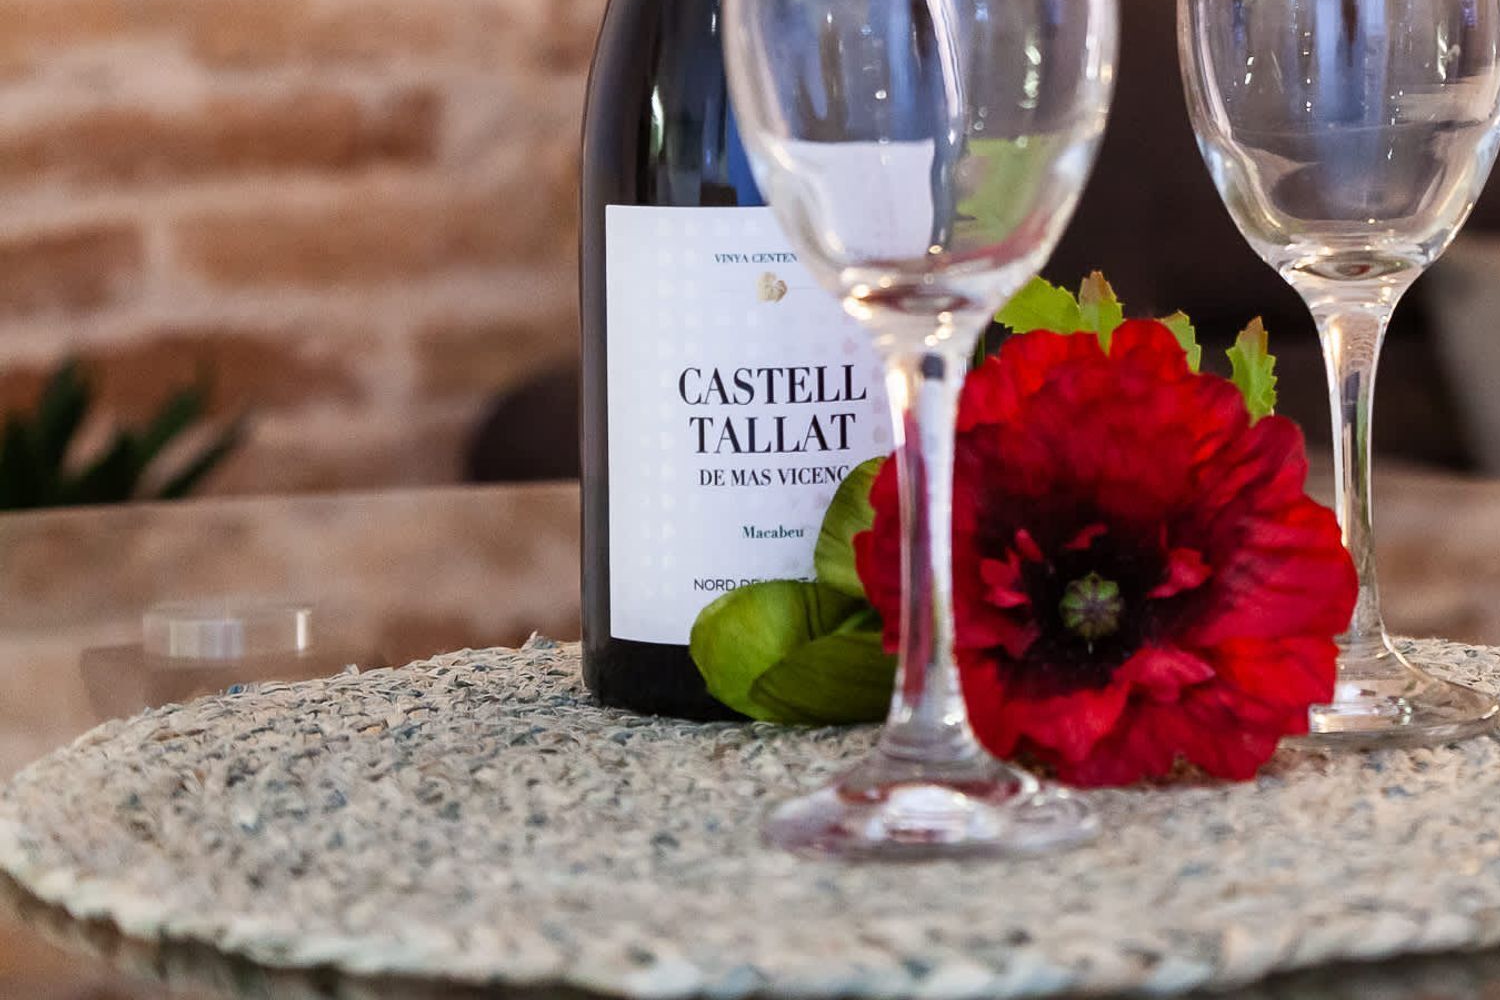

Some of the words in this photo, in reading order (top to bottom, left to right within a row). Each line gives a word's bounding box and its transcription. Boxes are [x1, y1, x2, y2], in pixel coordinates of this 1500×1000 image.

[713, 253, 749, 263] VINYA
[678, 364, 867, 406] CASTELL
[689, 413, 856, 454] TALLAT
[699, 469, 725, 486] DE
[730, 468, 772, 486] MAS
[742, 524, 805, 539] Macabeu
[694, 578, 736, 591] NORD
